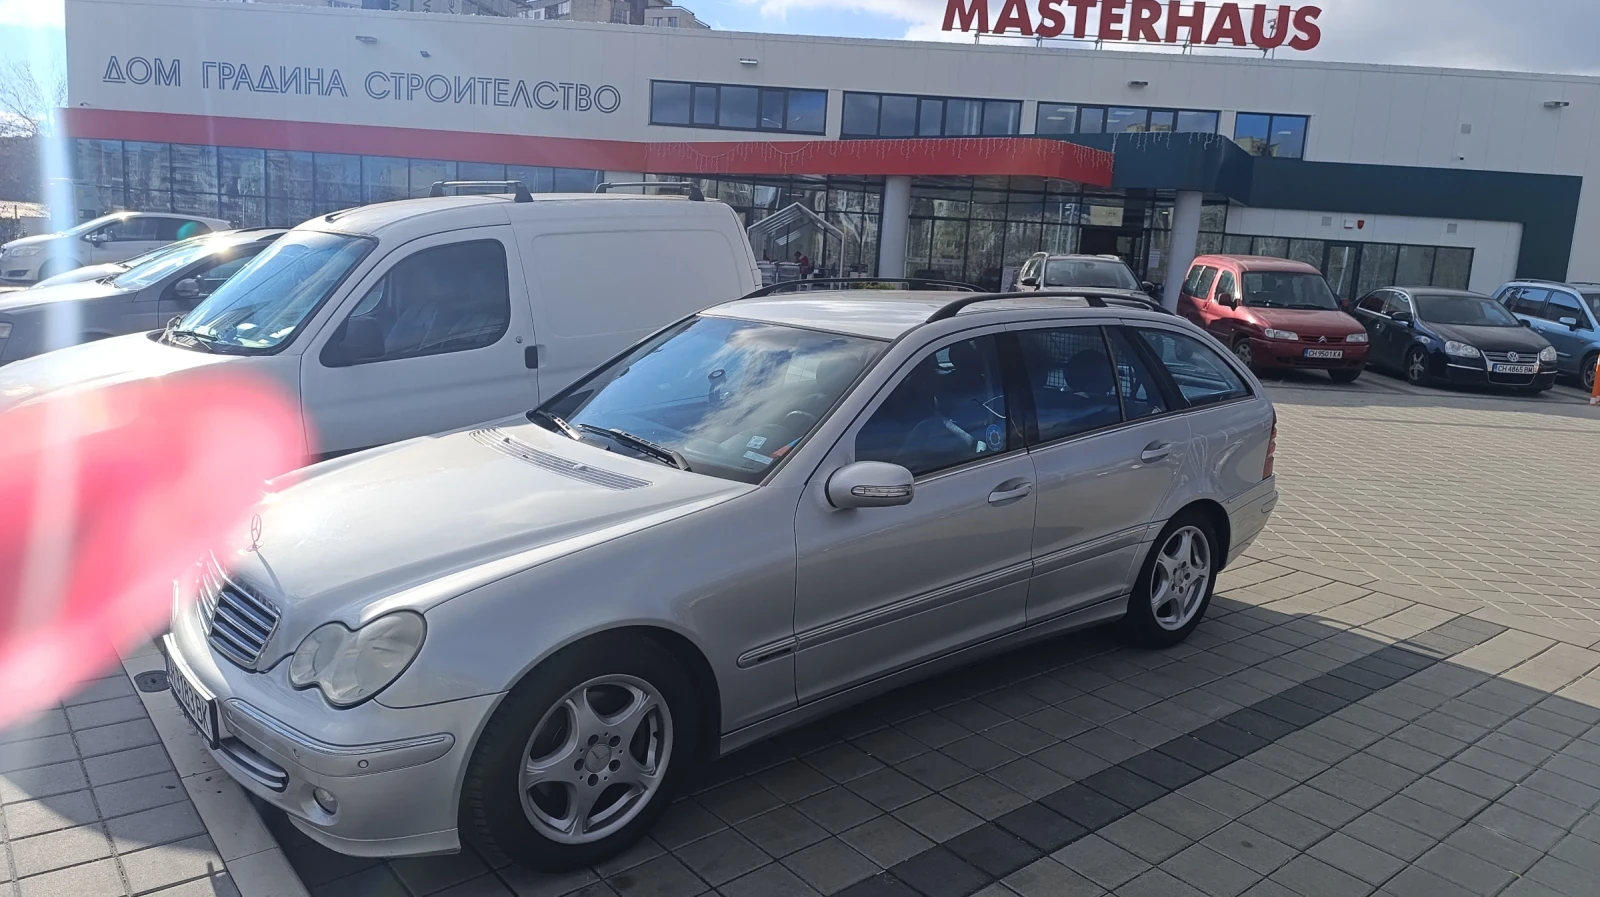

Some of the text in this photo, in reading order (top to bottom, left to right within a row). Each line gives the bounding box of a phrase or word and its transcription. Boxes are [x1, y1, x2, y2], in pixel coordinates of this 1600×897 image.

[942, 0, 1322, 51] MASTERHAUS
[103, 55, 621, 114] ДОМ ГРАДИНА СТРОИТЕЛСТВО
